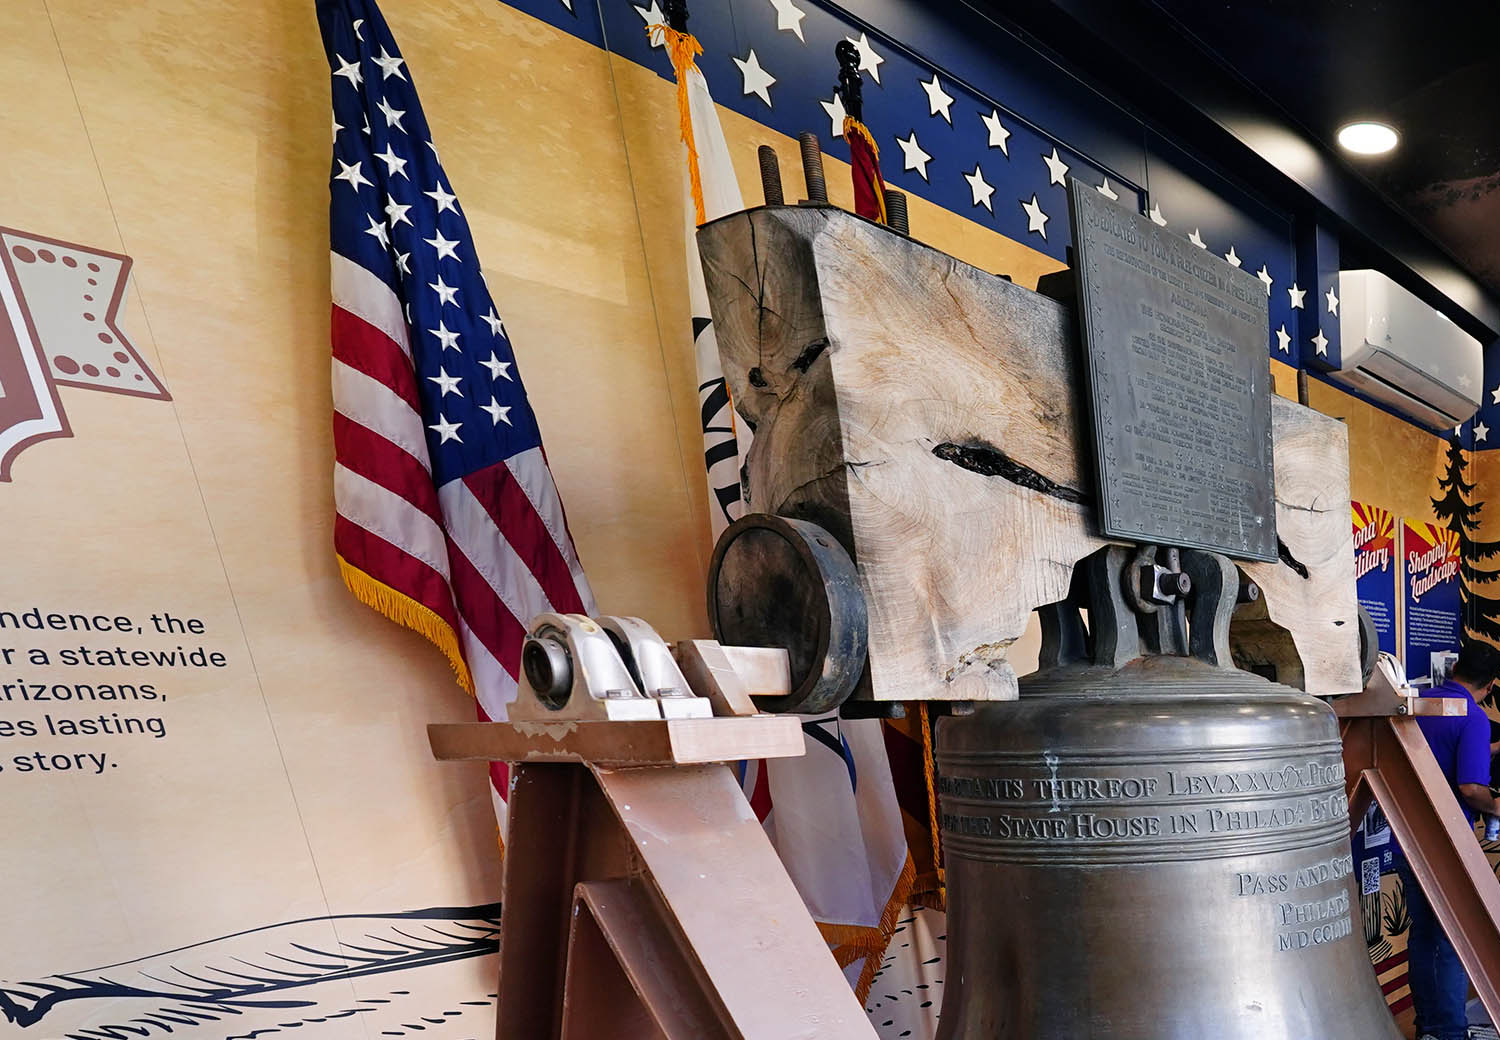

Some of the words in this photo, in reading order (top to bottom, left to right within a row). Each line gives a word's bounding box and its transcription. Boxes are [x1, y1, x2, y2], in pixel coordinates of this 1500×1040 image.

[1408, 541, 1447, 574] Shaping
[1411, 560, 1457, 603] Landscape
[0, 608, 142, 634] ndence,
[151, 613, 205, 634] the
[28, 648, 50, 665] a
[59, 646, 228, 667] statewide
[0, 678, 167, 702] rizonans,
[45, 713, 167, 738] lasting
[13, 752, 118, 774] story.
[1032, 776, 1158, 801] THEREOF
[999, 814, 1066, 840] STATE
[1071, 813, 1161, 840] HOUSE
[1170, 814, 1198, 834] IN
[1237, 871, 1289, 897] PASS
[1295, 863, 1329, 888] AND
